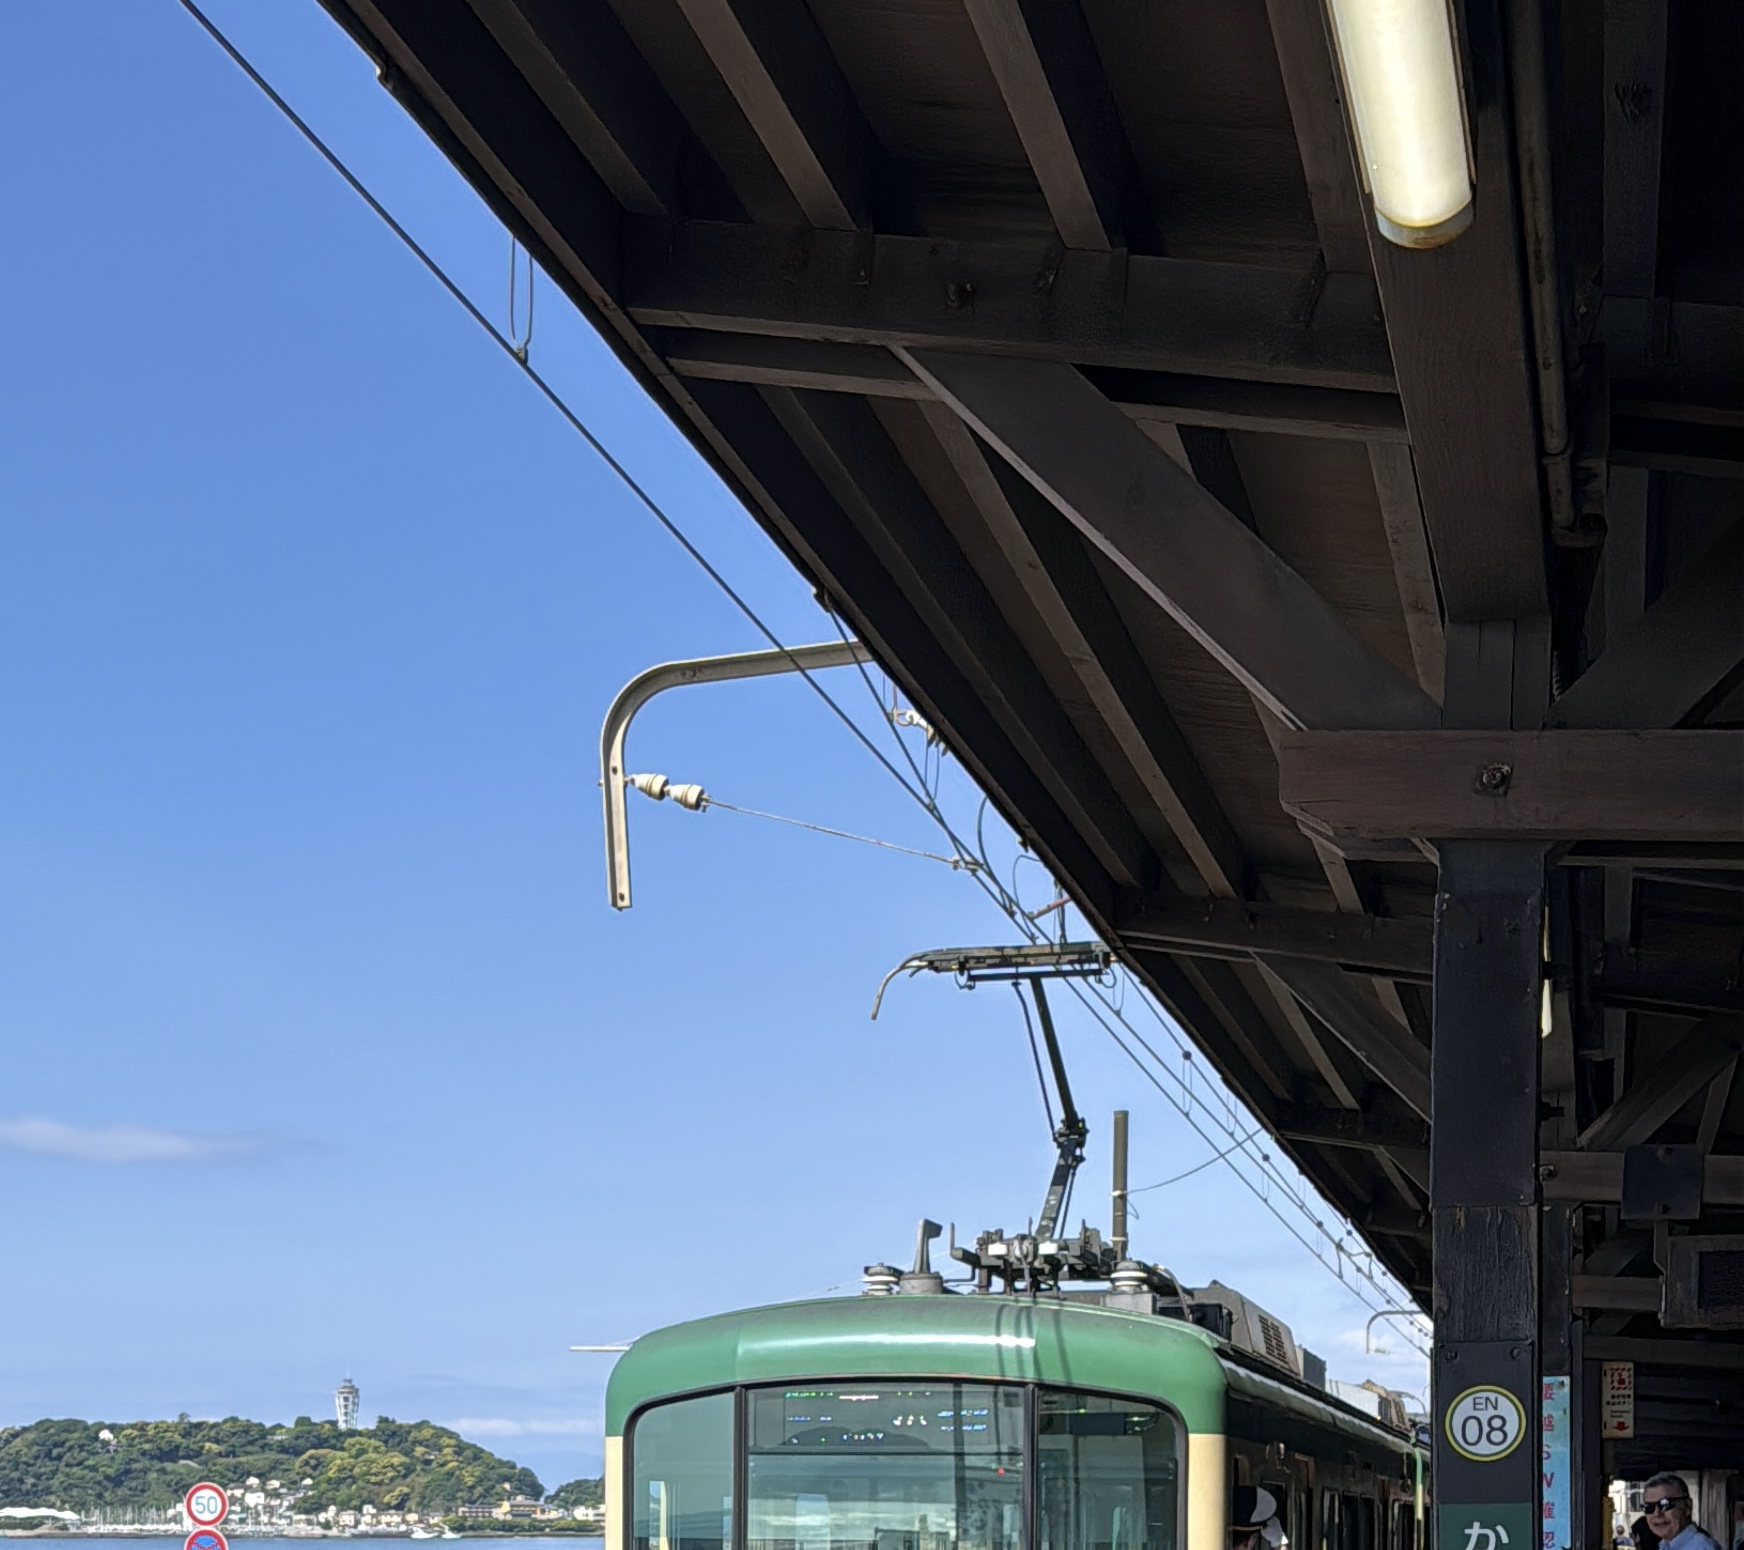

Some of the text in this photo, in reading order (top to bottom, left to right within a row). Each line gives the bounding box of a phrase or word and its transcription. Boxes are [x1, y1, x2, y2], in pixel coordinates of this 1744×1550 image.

[1472, 1396, 1499, 1412] EN
[1461, 1414, 1509, 1447] 08
[195, 1495, 218, 1515] 50
